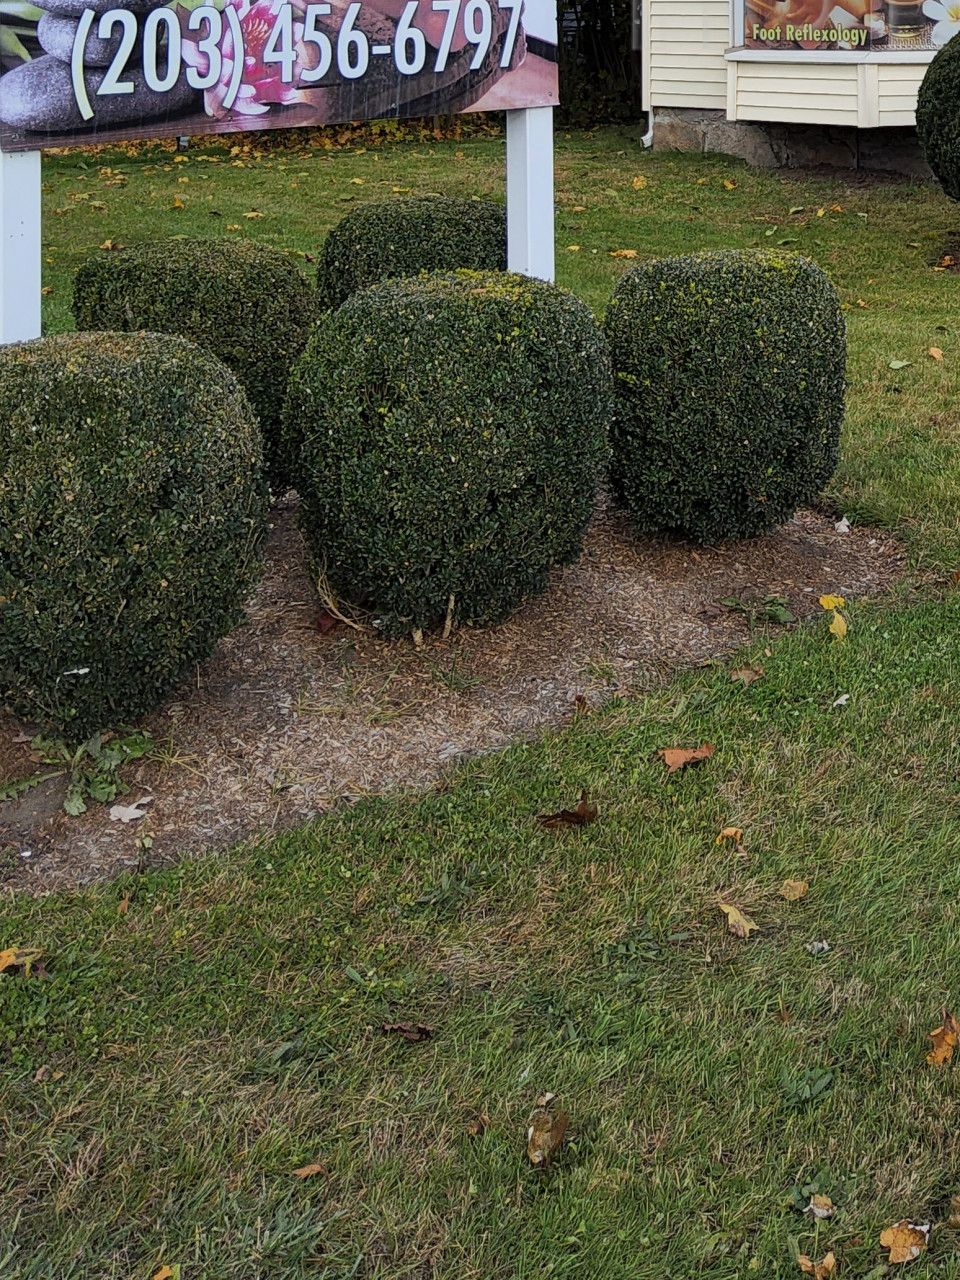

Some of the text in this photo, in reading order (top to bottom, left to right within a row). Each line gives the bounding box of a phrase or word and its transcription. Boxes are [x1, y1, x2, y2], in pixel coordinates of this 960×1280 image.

[71, 7, 244, 120] (203)
[752, 23, 868, 47] Foot Reflexology
